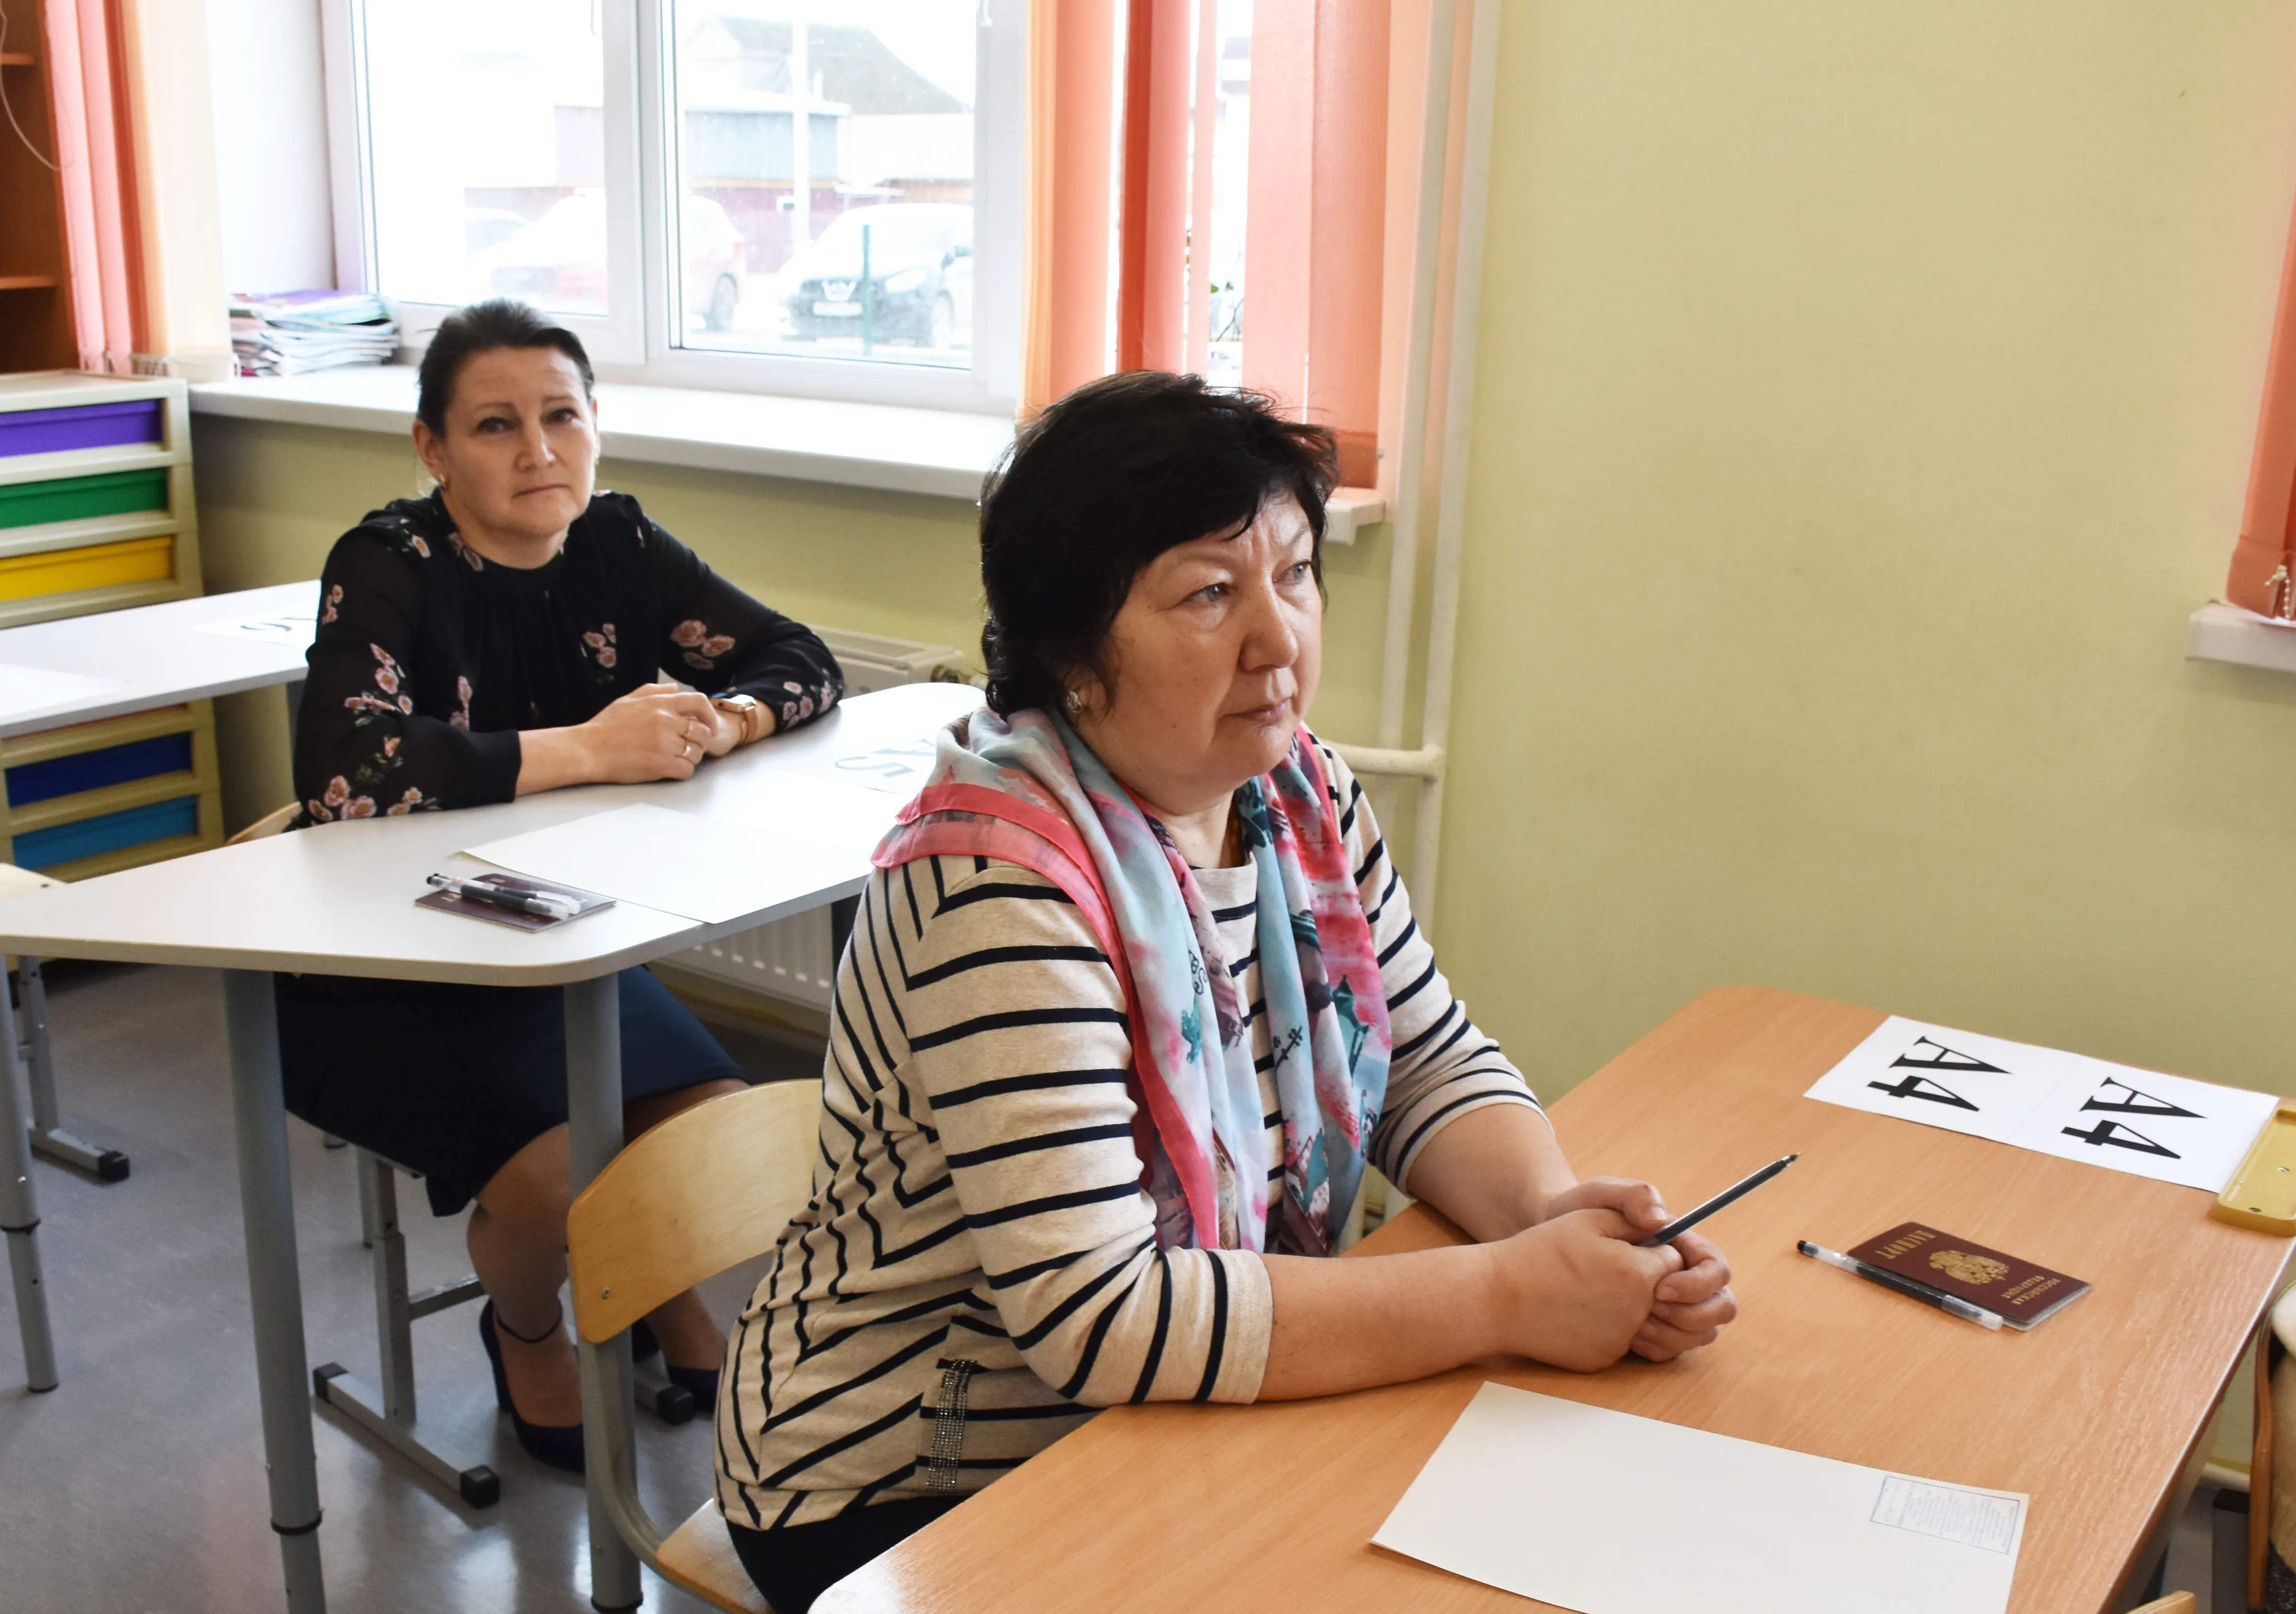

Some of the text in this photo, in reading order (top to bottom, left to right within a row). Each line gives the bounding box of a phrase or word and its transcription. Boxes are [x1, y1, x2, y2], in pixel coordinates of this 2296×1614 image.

[1867, 1036, 2011, 1112] A4
[2061, 1077, 2208, 1159] A4
[1875, 1230, 1936, 1259] ПАСПОРТ
